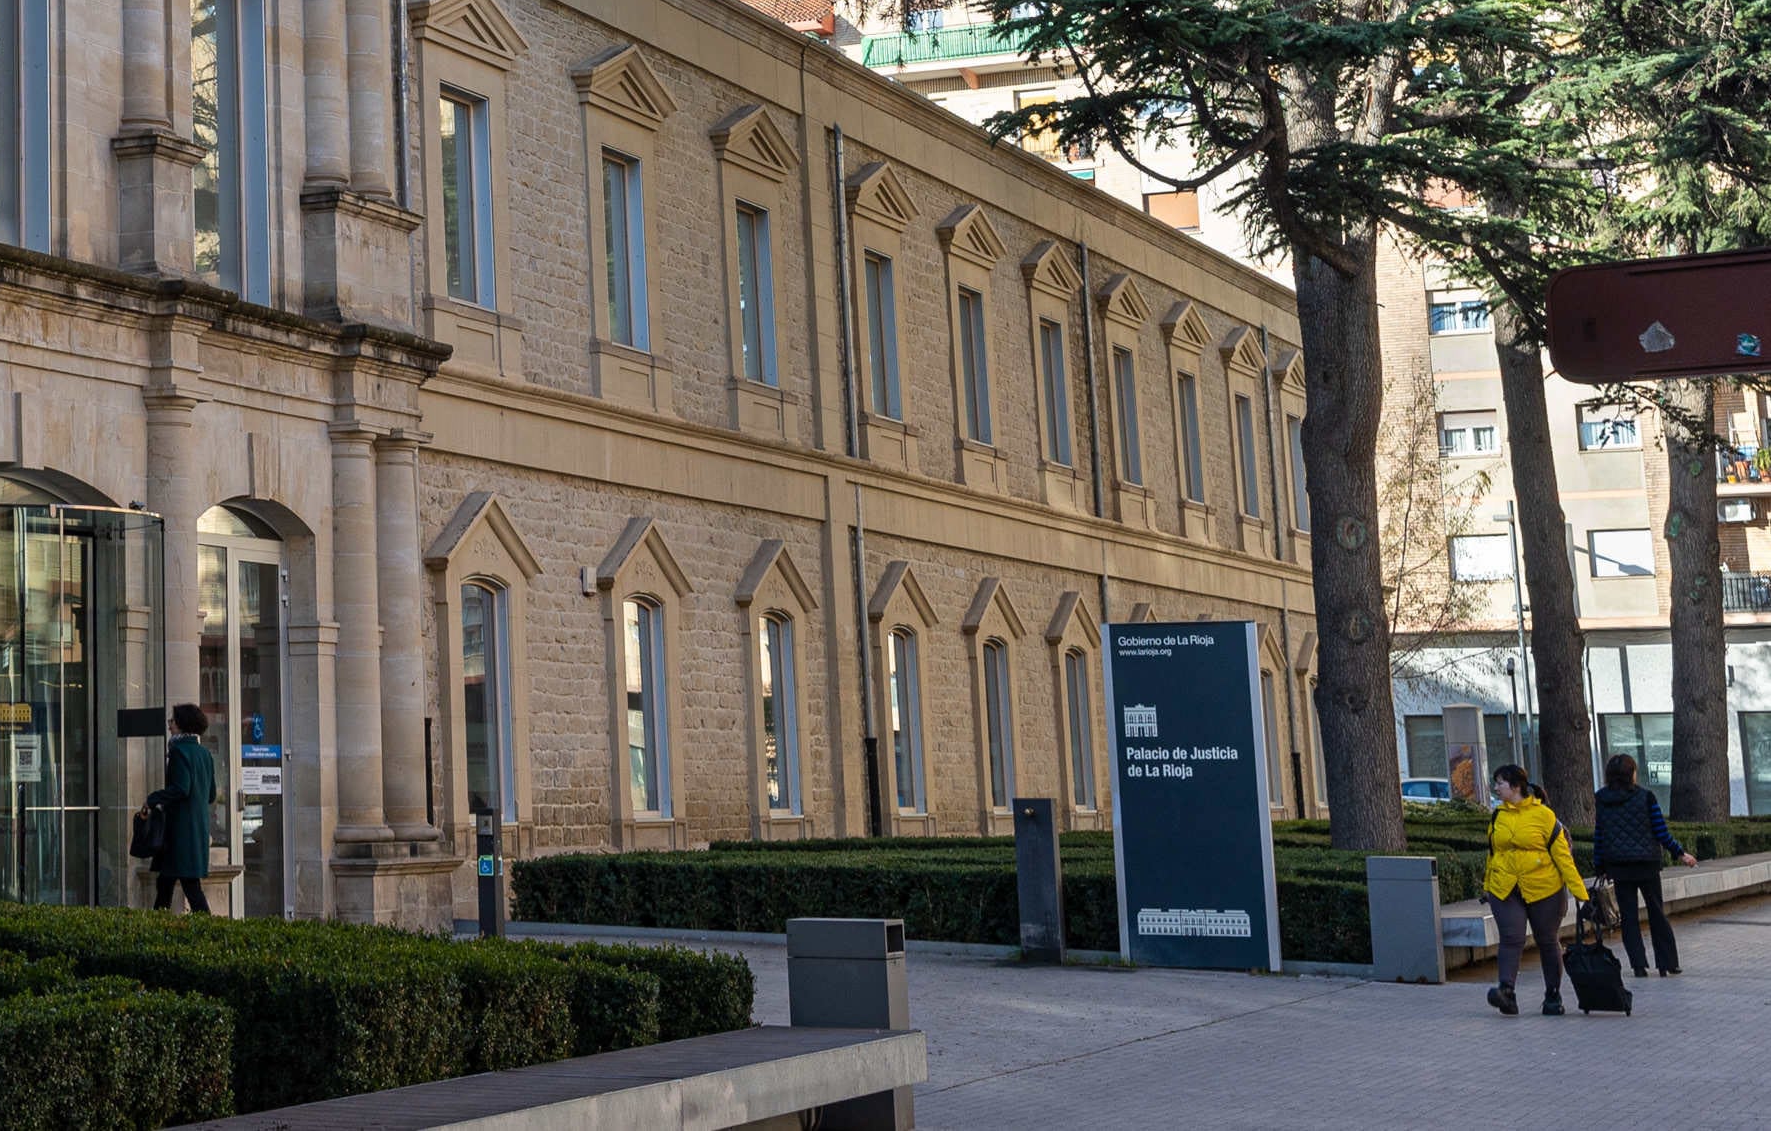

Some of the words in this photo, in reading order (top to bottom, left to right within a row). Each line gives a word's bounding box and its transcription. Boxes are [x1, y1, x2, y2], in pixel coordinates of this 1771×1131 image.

[1117, 636, 1162, 647] Gobierno
[1163, 635, 1176, 646] de
[1177, 635, 1189, 646] La
[1190, 634, 1215, 647] Rioja
[1118, 648, 1172, 657] www.larioja.org
[1126, 746, 1170, 760] Palacio
[1172, 746, 1188, 760] de
[1190, 746, 1238, 760] Justicia
[1127, 763, 1143, 777] de
[1145, 763, 1160, 777] La
[1162, 763, 1193, 780] Rioja
